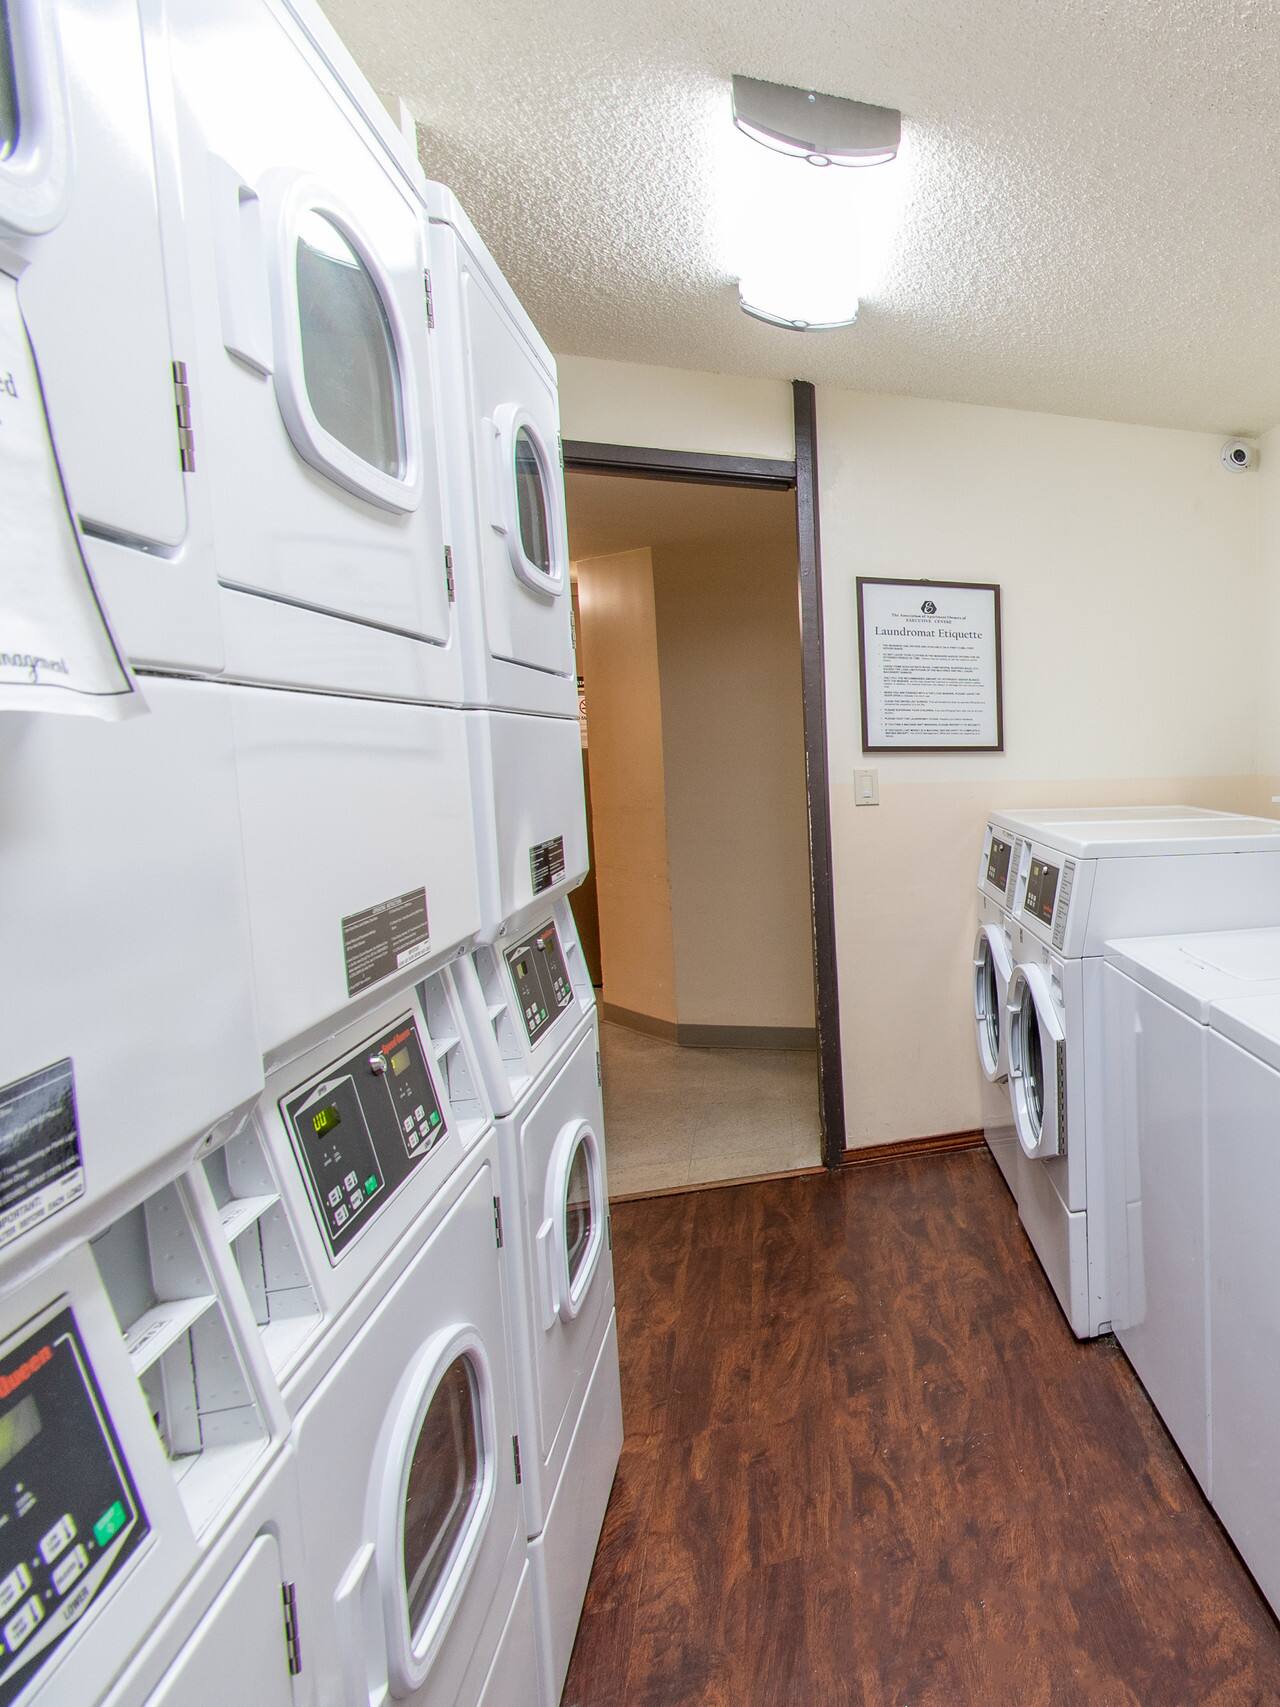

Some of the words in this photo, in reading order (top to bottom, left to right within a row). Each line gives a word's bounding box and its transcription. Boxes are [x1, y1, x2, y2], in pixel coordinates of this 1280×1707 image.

[875, 626, 936, 638] Laundromat
[938, 628, 983, 641] Etiquette
[63, 1586, 90, 1621] LOWER
